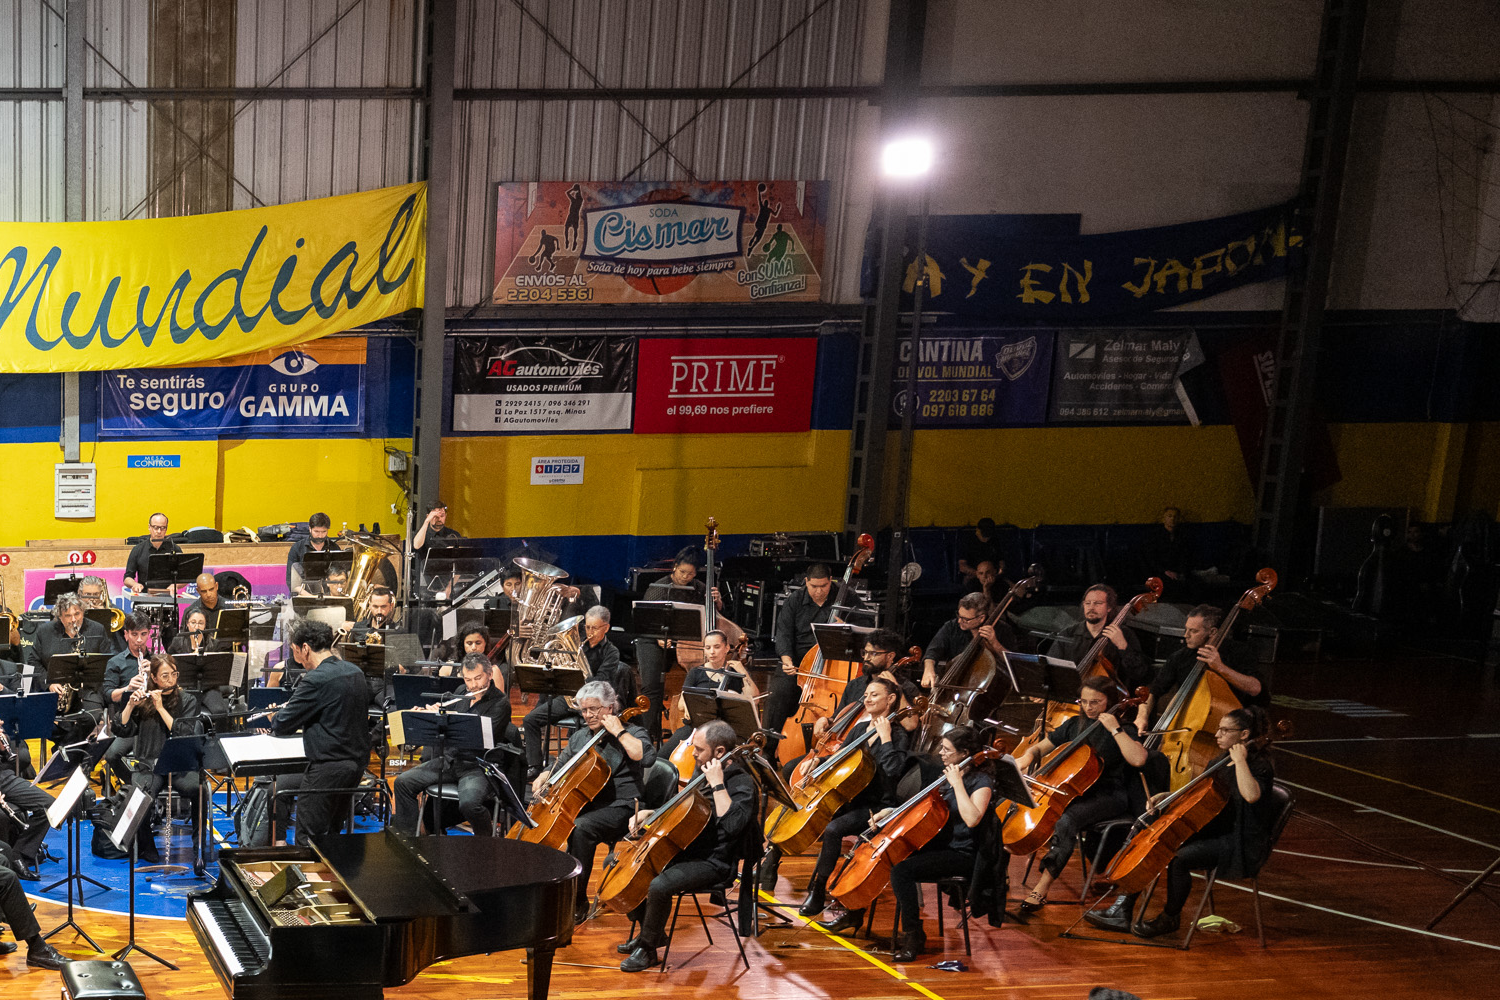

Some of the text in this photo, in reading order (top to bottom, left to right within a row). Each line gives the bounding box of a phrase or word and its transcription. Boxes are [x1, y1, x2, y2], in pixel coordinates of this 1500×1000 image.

[649, 208, 679, 218] SODA
[594, 211, 733, 256] Cismar
[587, 261, 612, 273] Soda
[613, 264, 625, 274] de
[627, 264, 645, 277] hoy
[647, 267, 669, 277] para
[697, 260, 734, 272] siempre
[515, 273, 587, 286] ENVÍOS AL
[1017, 260, 1093, 304] EN
[507, 288, 593, 300] 2204 5361
[750, 276, 805, 300] Confianza!
[1133, 354, 1144, 363] de
[1145, 354, 1179, 364] Seguros
[669, 360, 777, 393] PRIME
[942, 366, 993, 378] MUNDIAL
[117, 374, 205, 389] Te sentirás
[268, 383, 319, 393] GRUPO
[506, 384, 582, 392] USADOS PREMIUM
[929, 389, 996, 402] 2203 67 64
[129, 391, 225, 417] seguro
[239, 396, 350, 418] GAMMA
[667, 404, 774, 417] el 99,69 nos prefiere
[922, 404, 945, 417] 097
